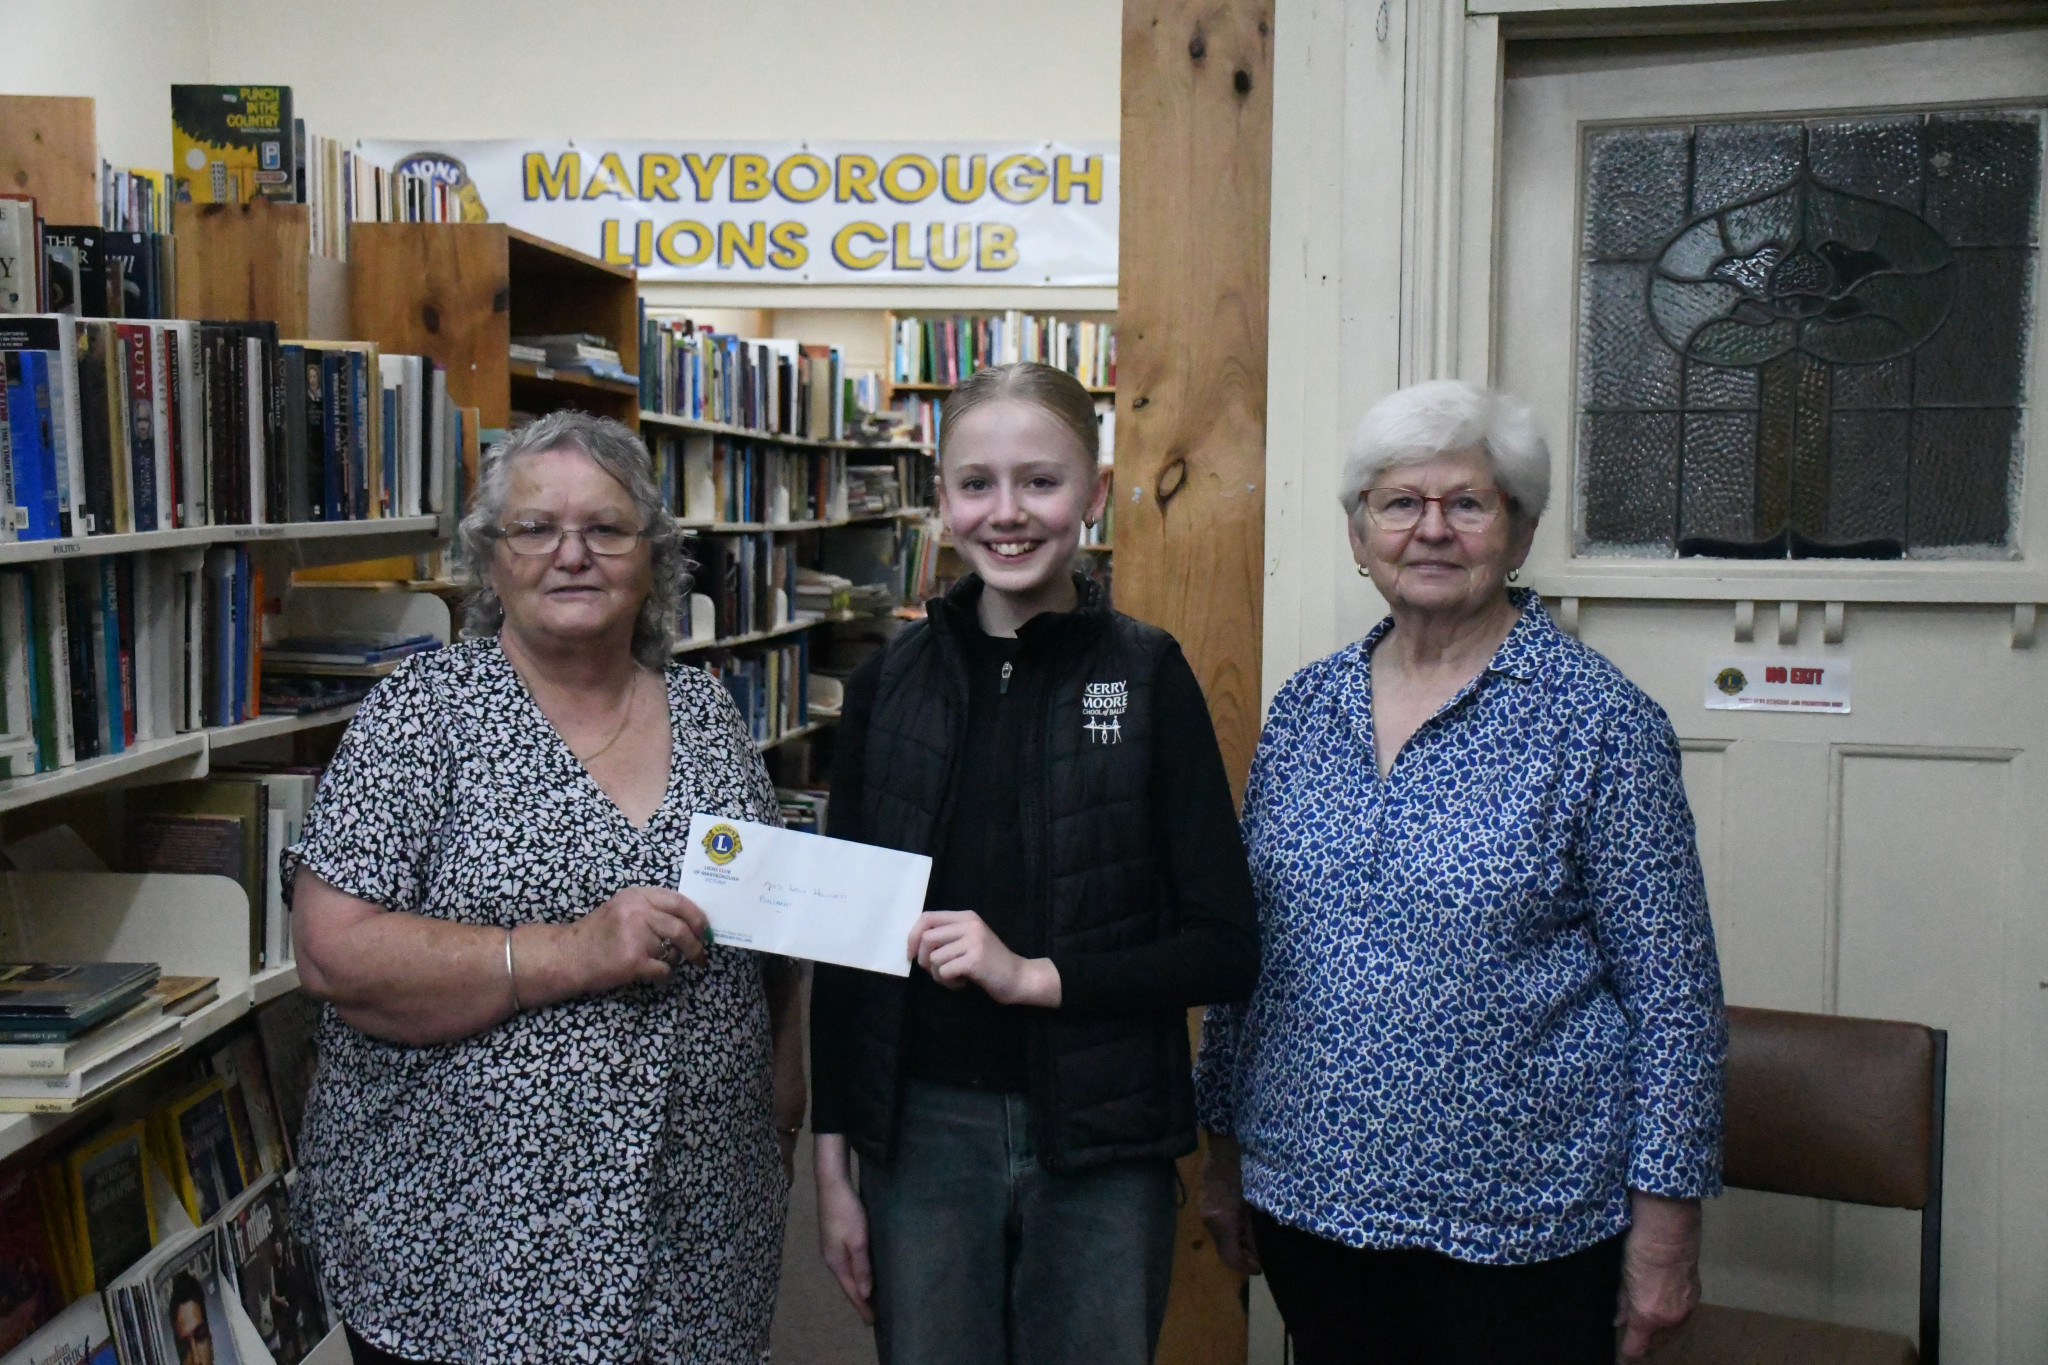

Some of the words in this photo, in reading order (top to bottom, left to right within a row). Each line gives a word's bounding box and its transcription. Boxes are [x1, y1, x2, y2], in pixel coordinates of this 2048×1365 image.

[240, 88, 279, 100] PUNCH
[227, 114, 279, 128] COUNTRY
[401, 159, 460, 184] LIONS
[522, 152, 1103, 205] MARYBOROUGH
[602, 220, 809, 272] LIONS
[831, 221, 1020, 272] CLUB
[134, 332, 147, 395] DUTY
[53, 543, 81, 554] POLITICS
[1790, 668, 1824, 685] EXIT
[1085, 680, 1127, 694] KERRY
[1082, 695, 1128, 709] MOORE
[716, 835, 727, 852] L
[701, 870, 740, 881] MARYBOROUGH
